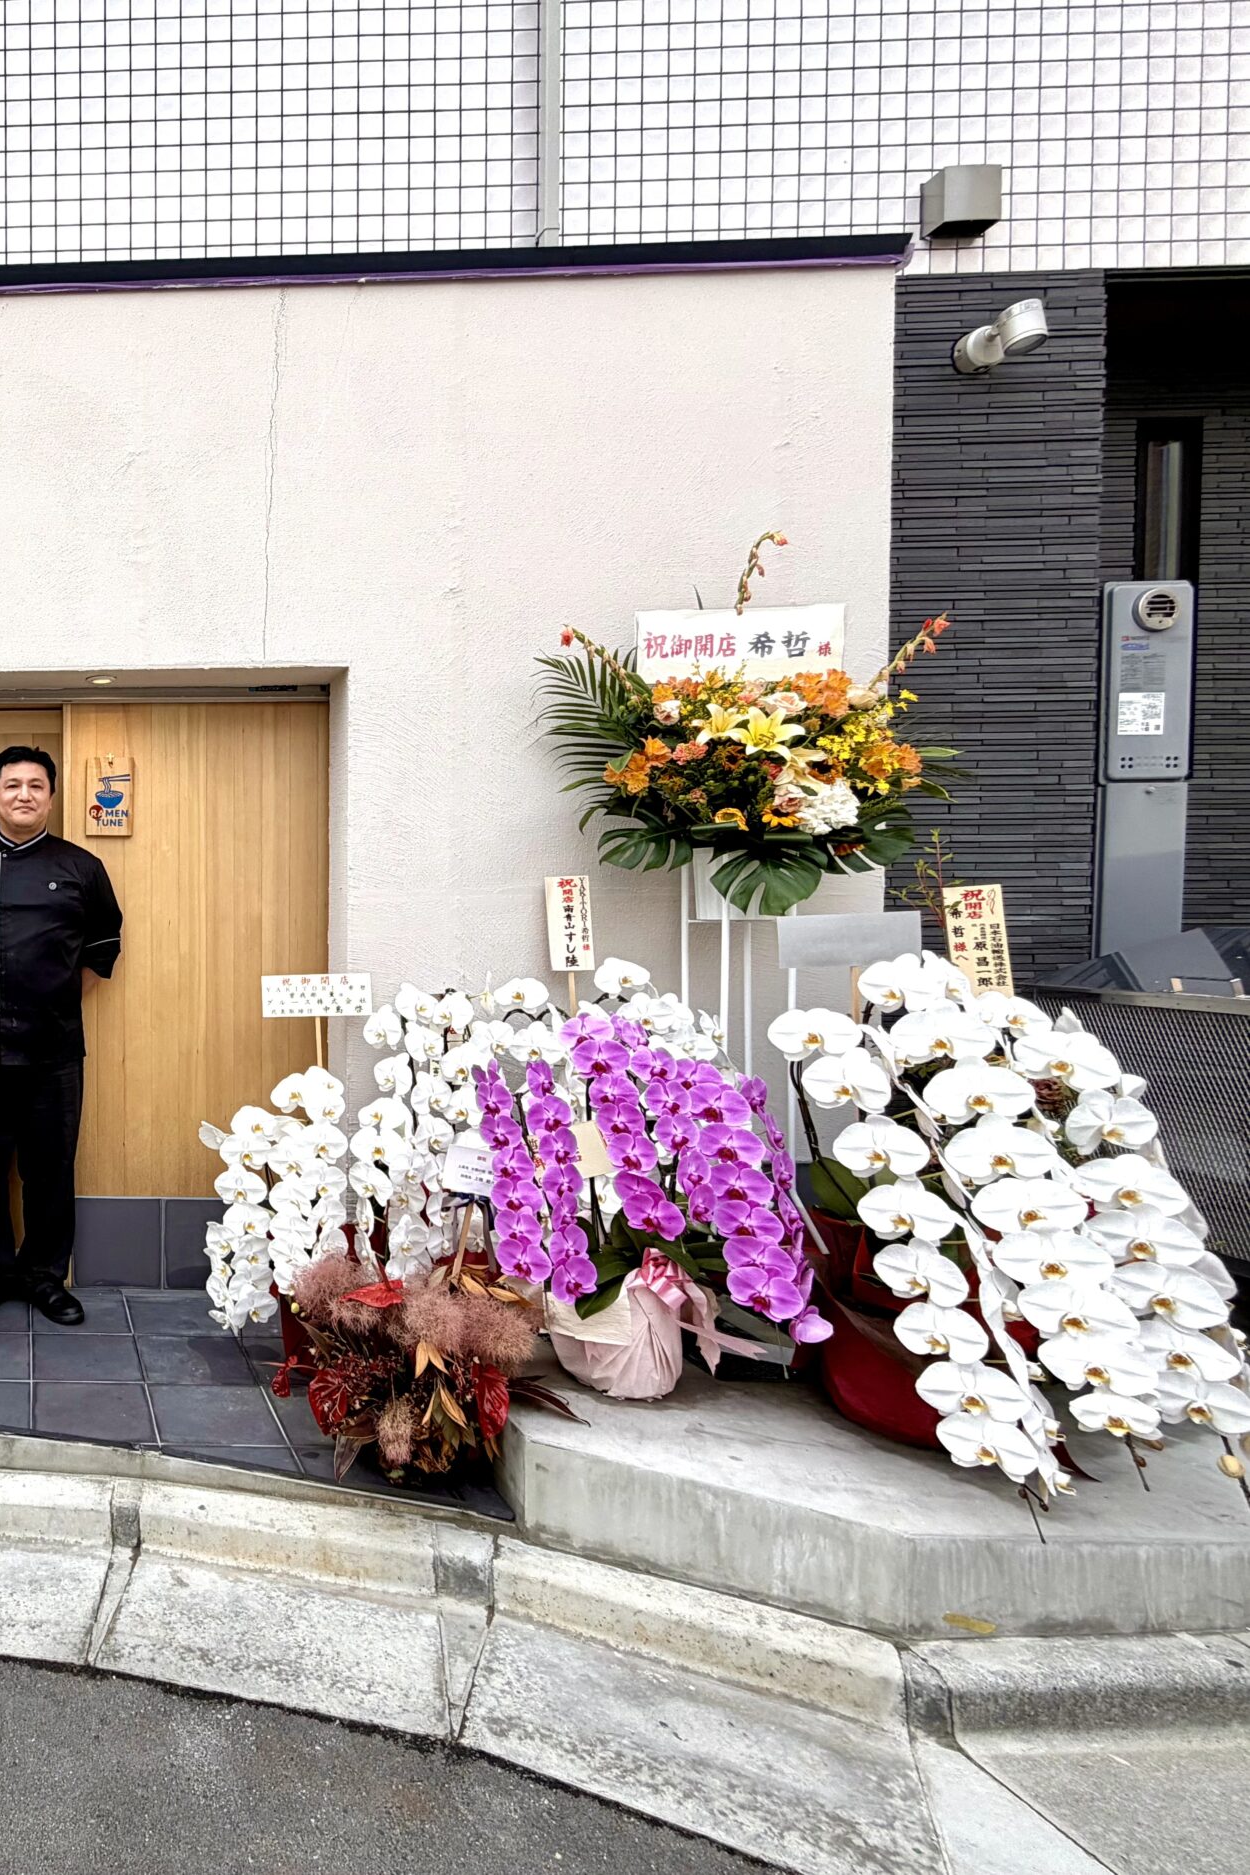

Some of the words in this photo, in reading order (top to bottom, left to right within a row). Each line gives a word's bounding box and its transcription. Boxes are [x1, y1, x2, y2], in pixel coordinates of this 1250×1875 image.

[643, 631, 736, 659] 祝御開店
[90, 808, 128, 818] RAMEN
[96, 818, 123, 826] TUNE
[557, 878, 577, 904] 祝開店
[960, 889, 986, 919] 祝開店
[282, 976, 349, 986] 祝御開店
